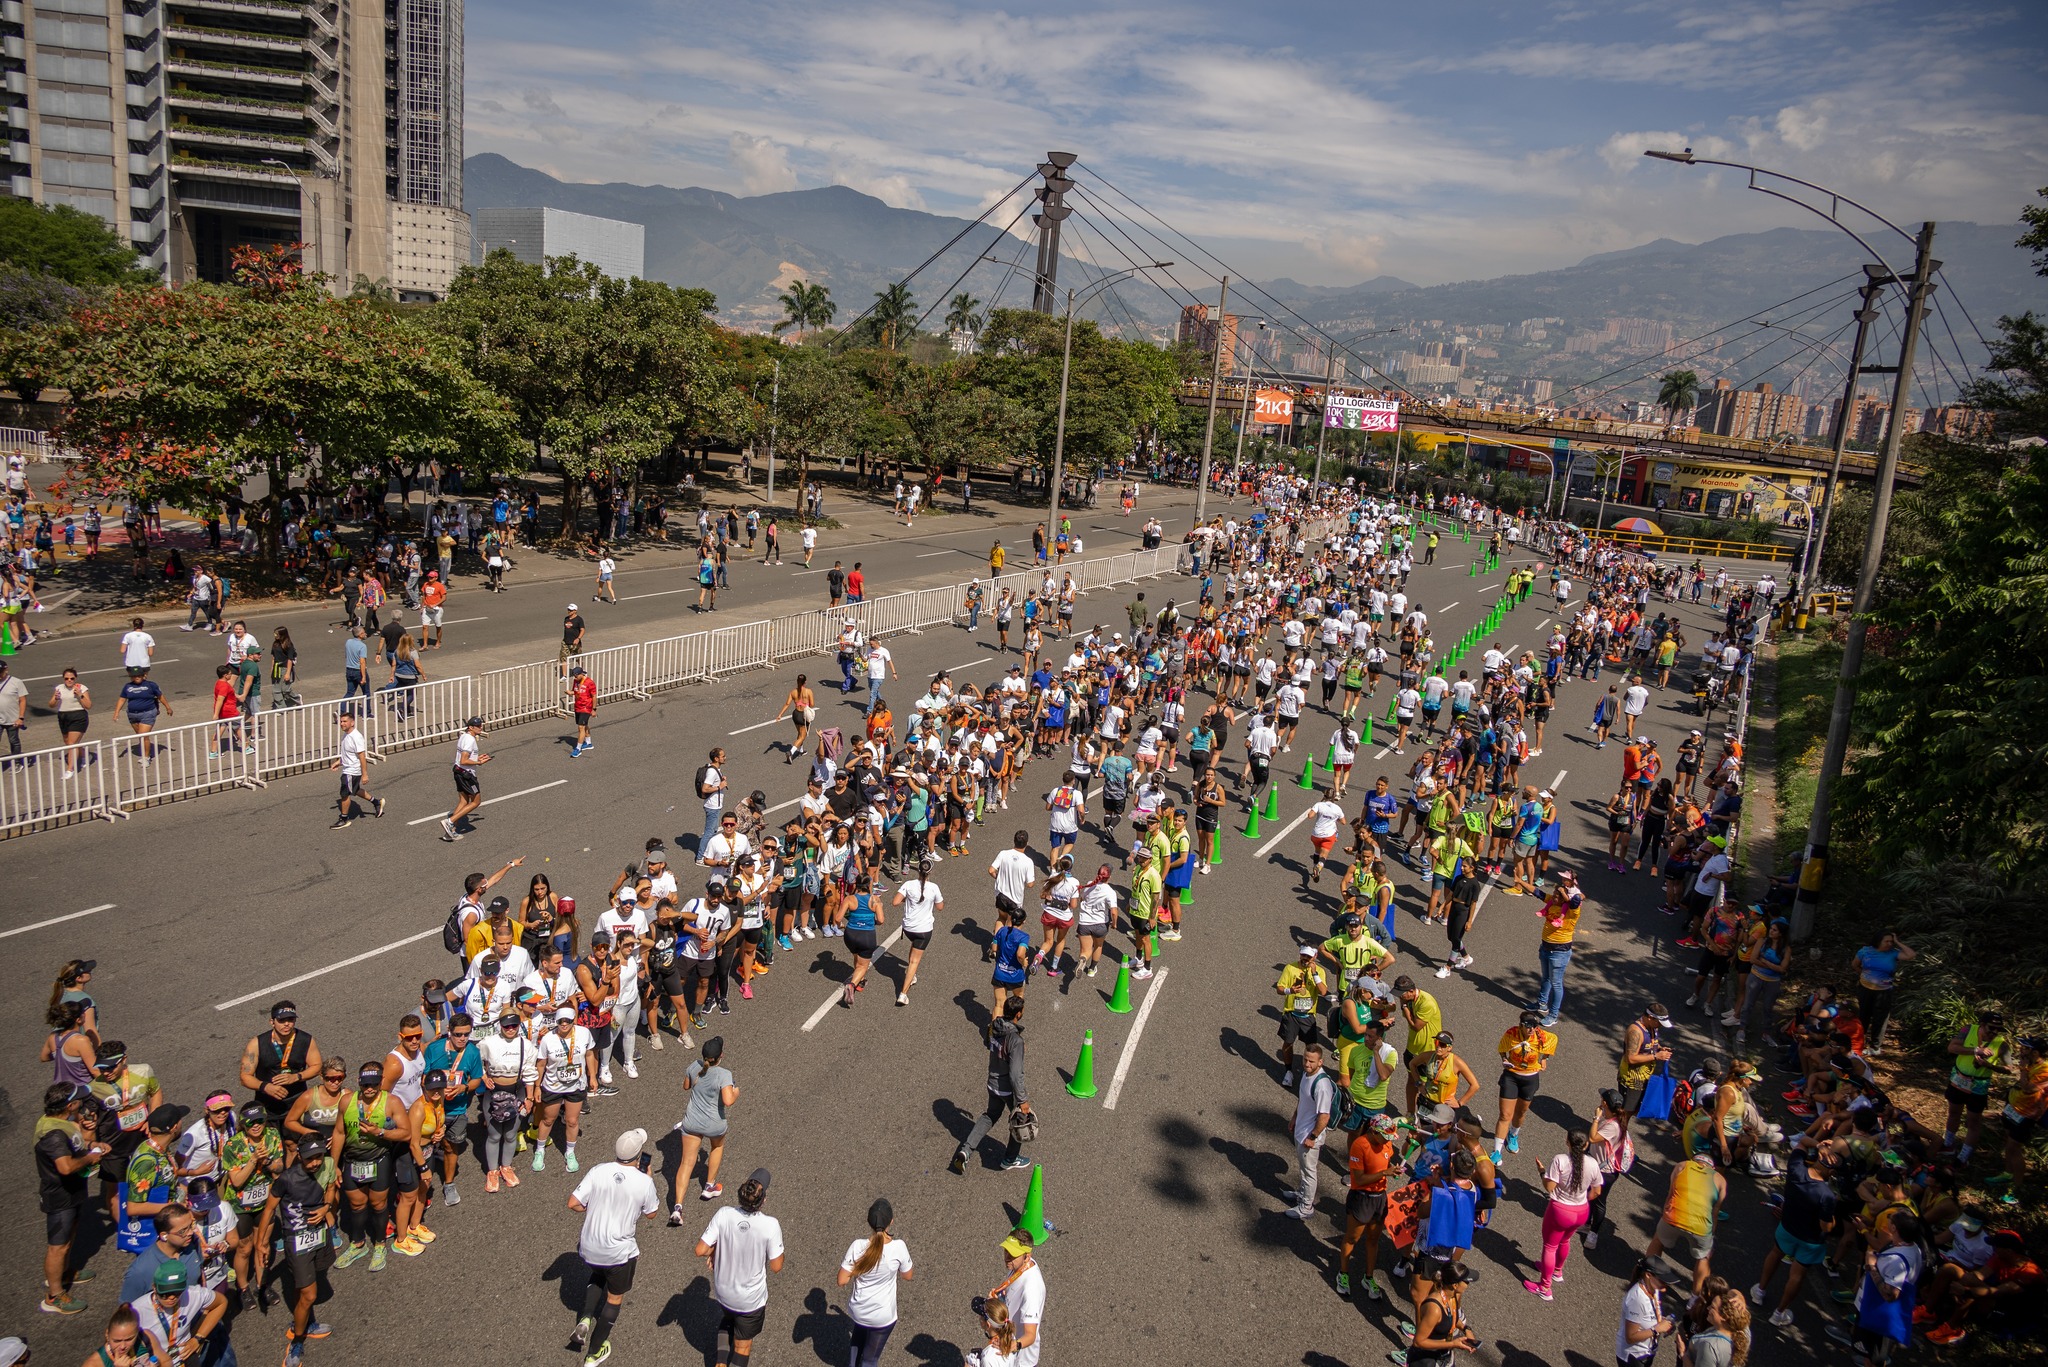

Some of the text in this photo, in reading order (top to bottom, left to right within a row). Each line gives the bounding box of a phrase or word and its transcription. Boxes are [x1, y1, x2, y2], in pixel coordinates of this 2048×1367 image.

[1255, 400, 1283, 415] 21K
[1326, 407, 1344, 417] 10K
[1347, 409, 1359, 419] 5K
[1363, 413, 1389, 427] 42K
[1681, 466, 1747, 479] DUNLOP
[1700, 479, 1739, 488] Maranatha
[1339, 946, 1372, 966] run
[122, 1111, 144, 1126] 2676
[247, 1187, 267, 1200] 7863
[299, 1231, 319, 1246] 7291
